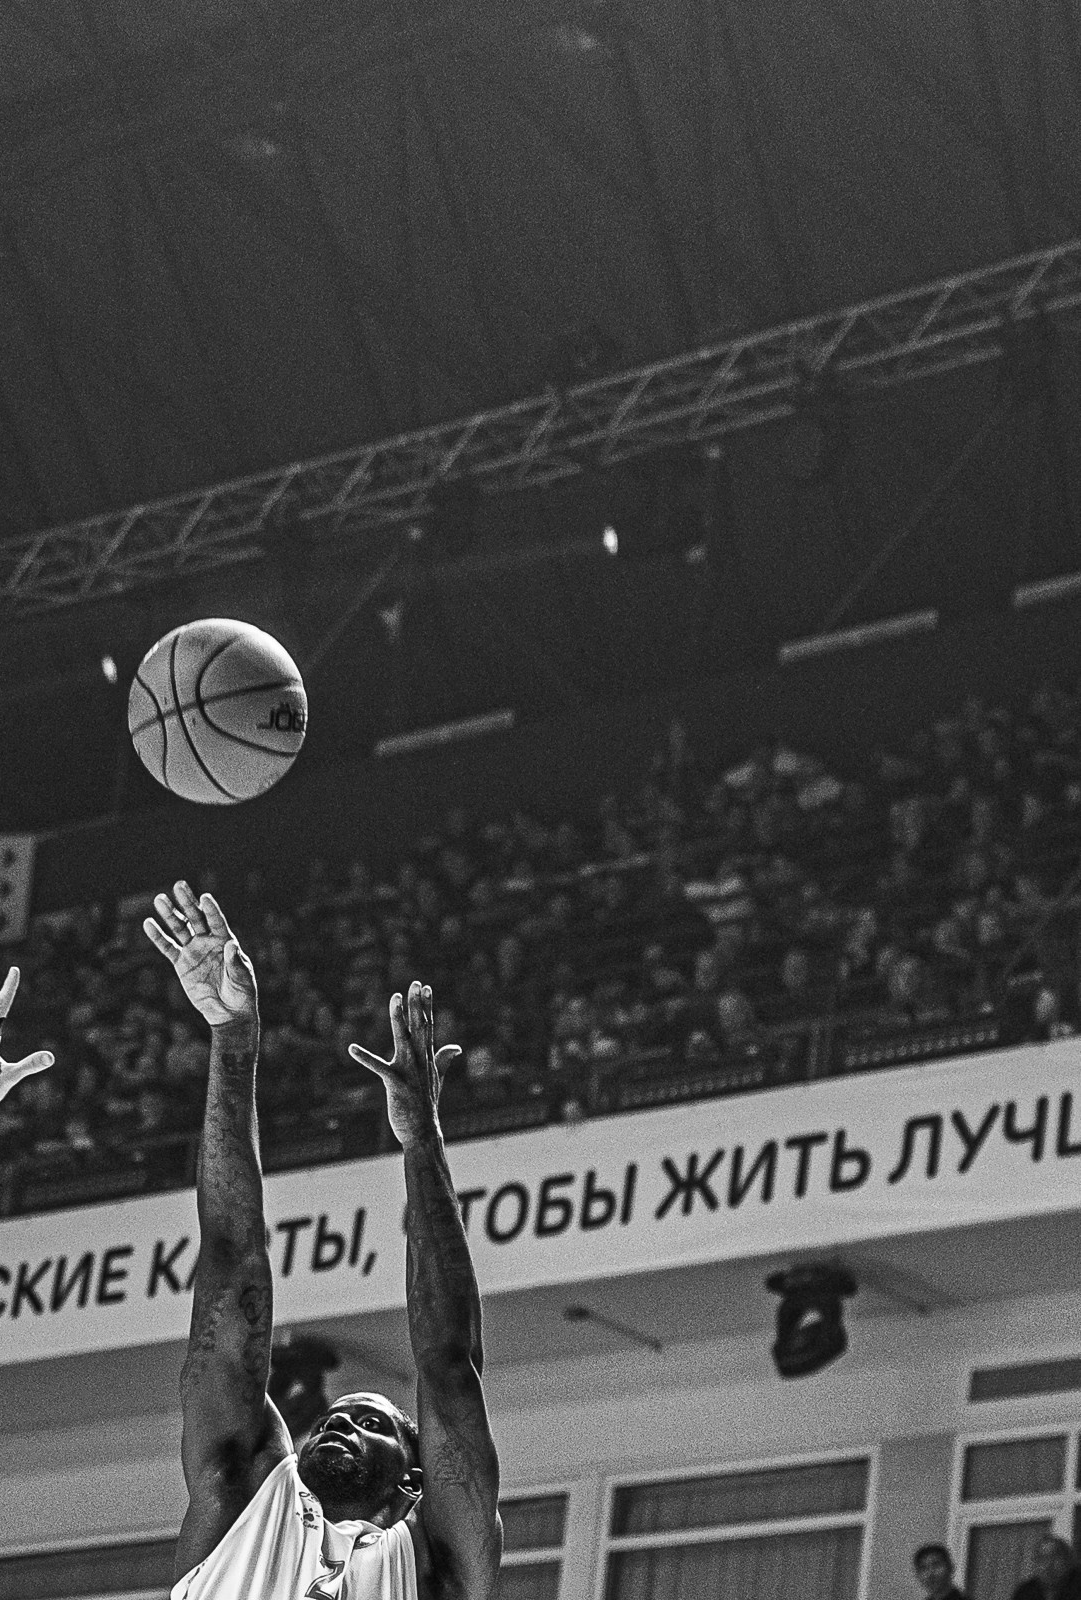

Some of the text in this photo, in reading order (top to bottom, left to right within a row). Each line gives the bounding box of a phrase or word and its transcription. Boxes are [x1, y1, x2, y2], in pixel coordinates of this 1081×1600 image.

[147, 1208, 378, 1299] КТЫ,
[403, 1163, 638, 1245] ТОБЫ
[655, 1127, 873, 1220] ЖИТЬ
